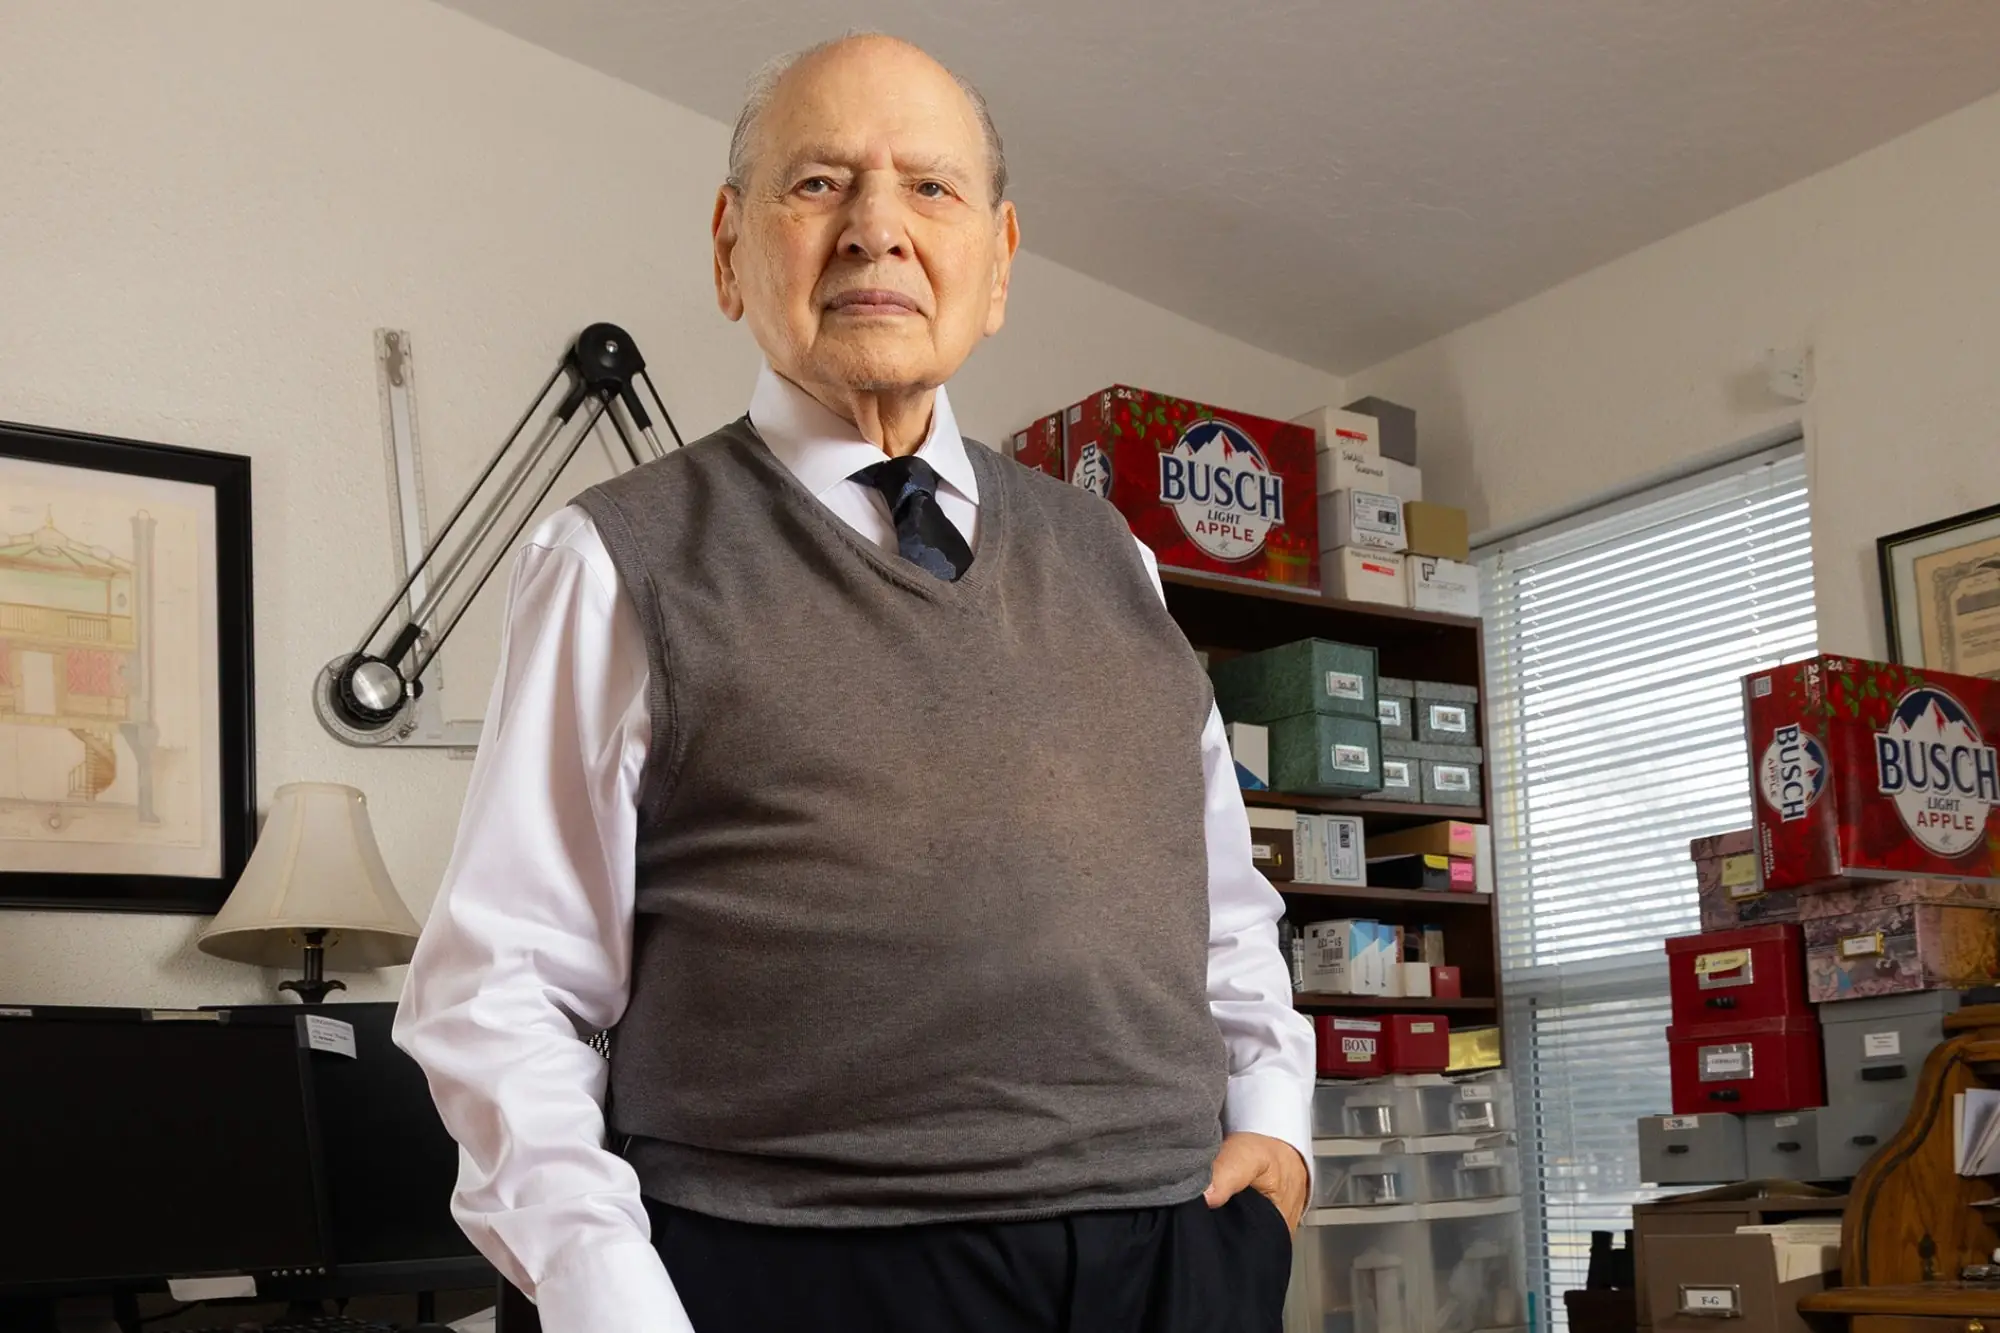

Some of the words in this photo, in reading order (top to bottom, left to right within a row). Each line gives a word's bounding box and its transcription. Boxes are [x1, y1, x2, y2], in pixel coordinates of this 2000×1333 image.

[1103, 392, 1111, 409] 24
[1117, 389, 1132, 400] 24
[1048, 417, 1056, 435] 24
[1082, 443, 1097, 495] BUS
[1161, 455, 1282, 520] BUSCH
[1207, 509, 1241, 525] LIGHT
[1195, 520, 1255, 543] APPLE
[1806, 664, 1820, 685] 24
[1827, 660, 1843, 672] 24
[1775, 728, 1805, 820] BUSCH
[1877, 735, 1999, 801] BUSCH
[1927, 796, 1961, 812] LIGHT
[1917, 811, 1975, 831] APPLE
[1343, 1039, 1368, 1053] BOX
[1700, 1296, 1720, 1305] F-G
